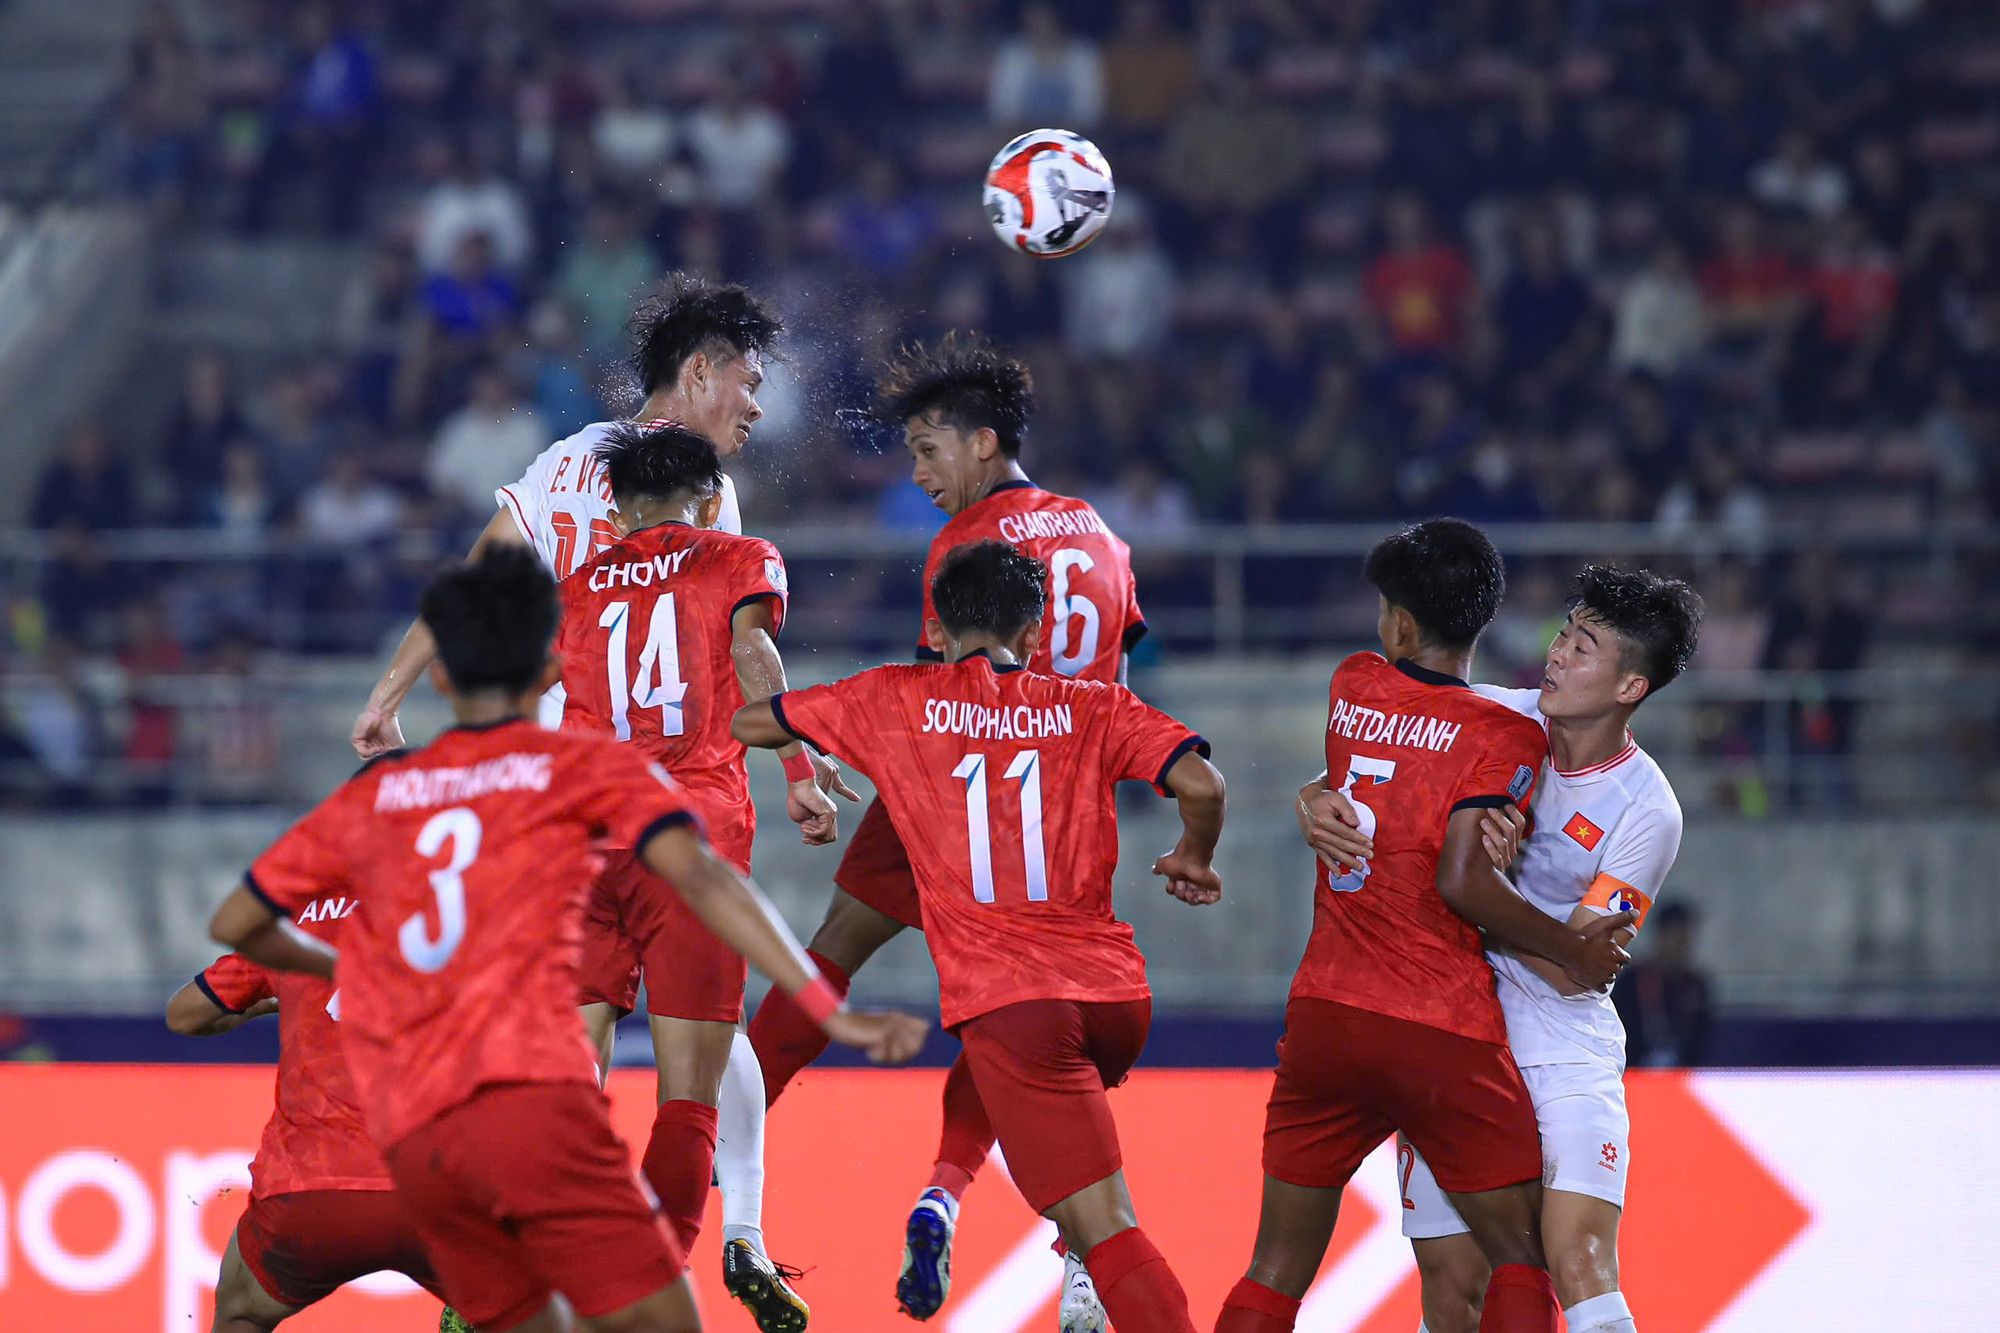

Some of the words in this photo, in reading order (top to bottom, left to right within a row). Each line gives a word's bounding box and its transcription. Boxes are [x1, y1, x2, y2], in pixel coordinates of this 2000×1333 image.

[549, 456, 572, 493] B.
[588, 547, 691, 593] CHONY
[1050, 547, 1100, 677] 6
[597, 591, 689, 742] 14
[921, 698, 1073, 740] SOUKPHACHAN
[1329, 698, 1463, 753] PHETDAVANH
[950, 749, 1049, 904] 11
[1328, 753, 1397, 893] 5
[398, 806, 483, 973] 3
